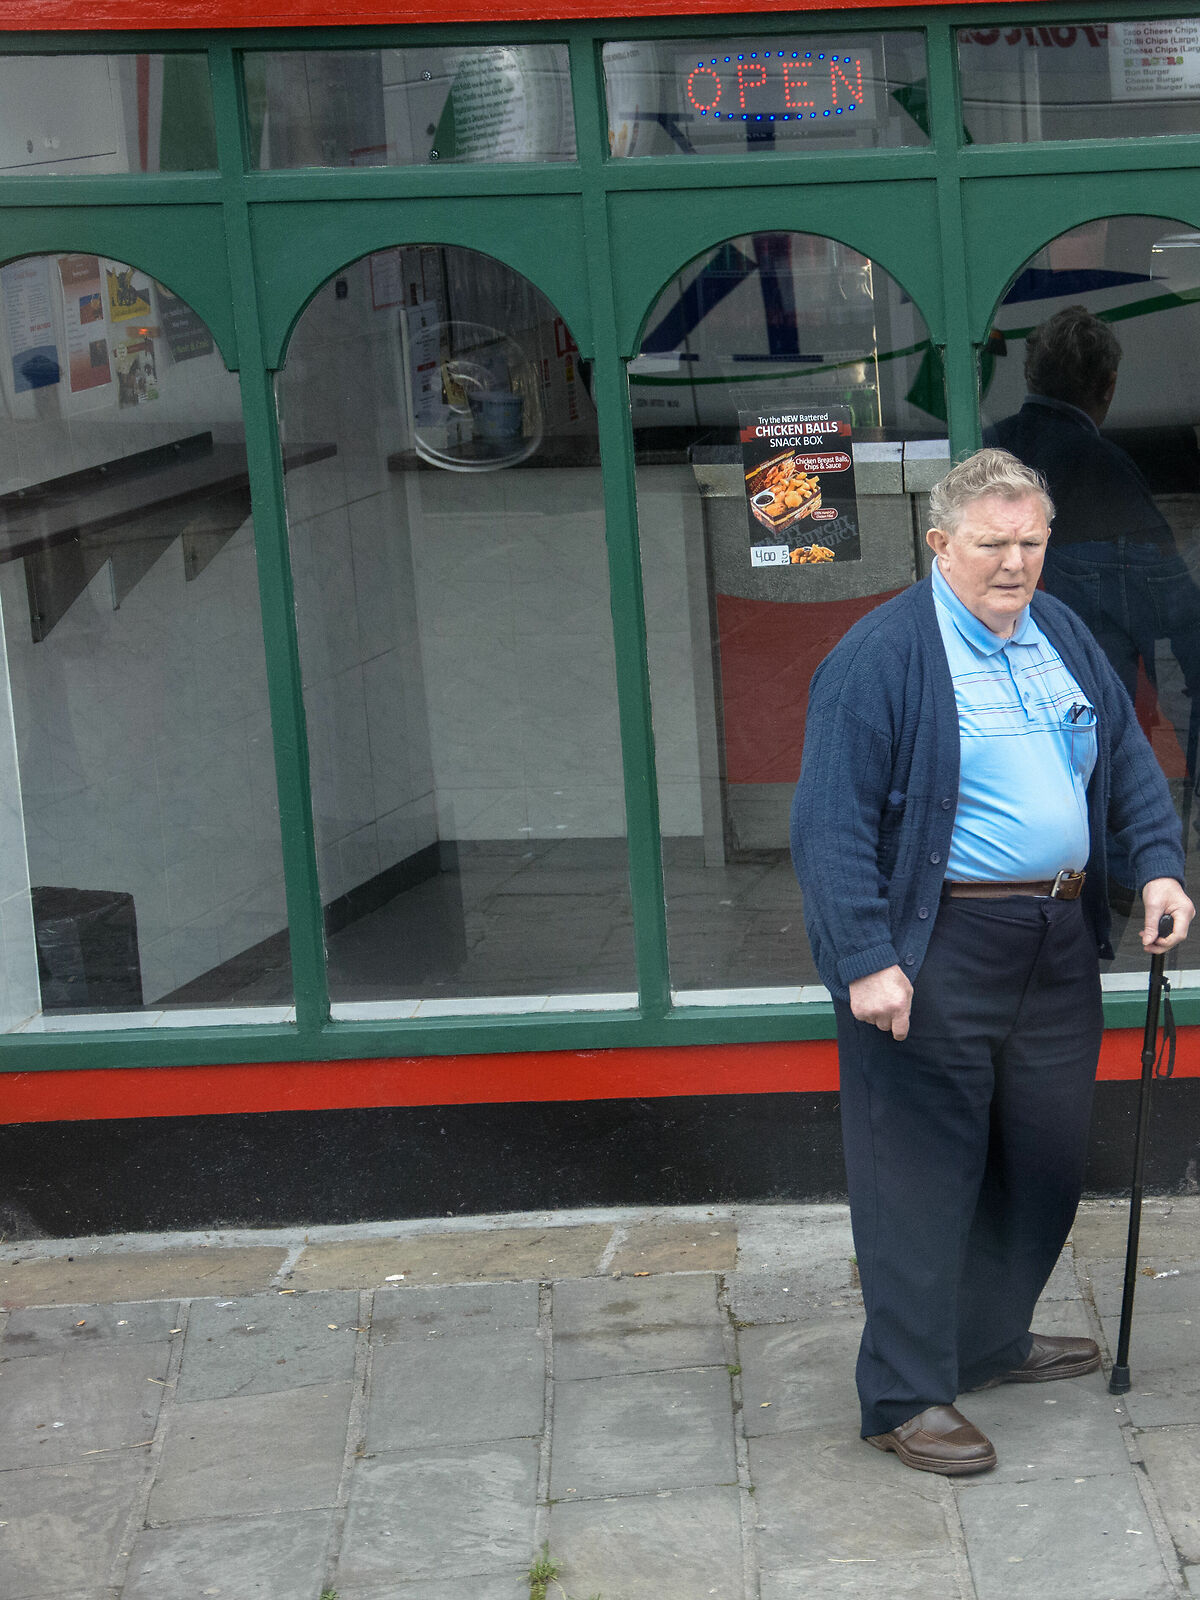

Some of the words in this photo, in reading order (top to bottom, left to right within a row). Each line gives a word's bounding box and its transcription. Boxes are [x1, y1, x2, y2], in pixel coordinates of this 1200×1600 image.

[1143, 27, 1173, 35] Cheese
[1175, 26, 1198, 34] Chips
[1145, 37, 1169, 45] Chips
[1170, 35, 1199, 45] (Large)
[1155, 46, 1178, 54] Chips
[1143, 68, 1169, 77] Burger
[1156, 76, 1183, 84] Burger
[687, 59, 864, 111] OPEN
[1155, 83, 1183, 92] Burger
[758, 416, 769, 425] Try
[769, 415, 781, 424] the
[781, 414, 798, 423] NEW
[799, 412, 829, 422] Battered
[755, 423, 803, 437] CHICKEN
[805, 421, 839, 434] BALLS
[769, 436, 802, 448] SNACK
[803, 435, 824, 446] BOX
[796, 457, 817, 465] Chicken
[817, 456, 834, 464] Breast
[804, 463, 819, 471] Chips
